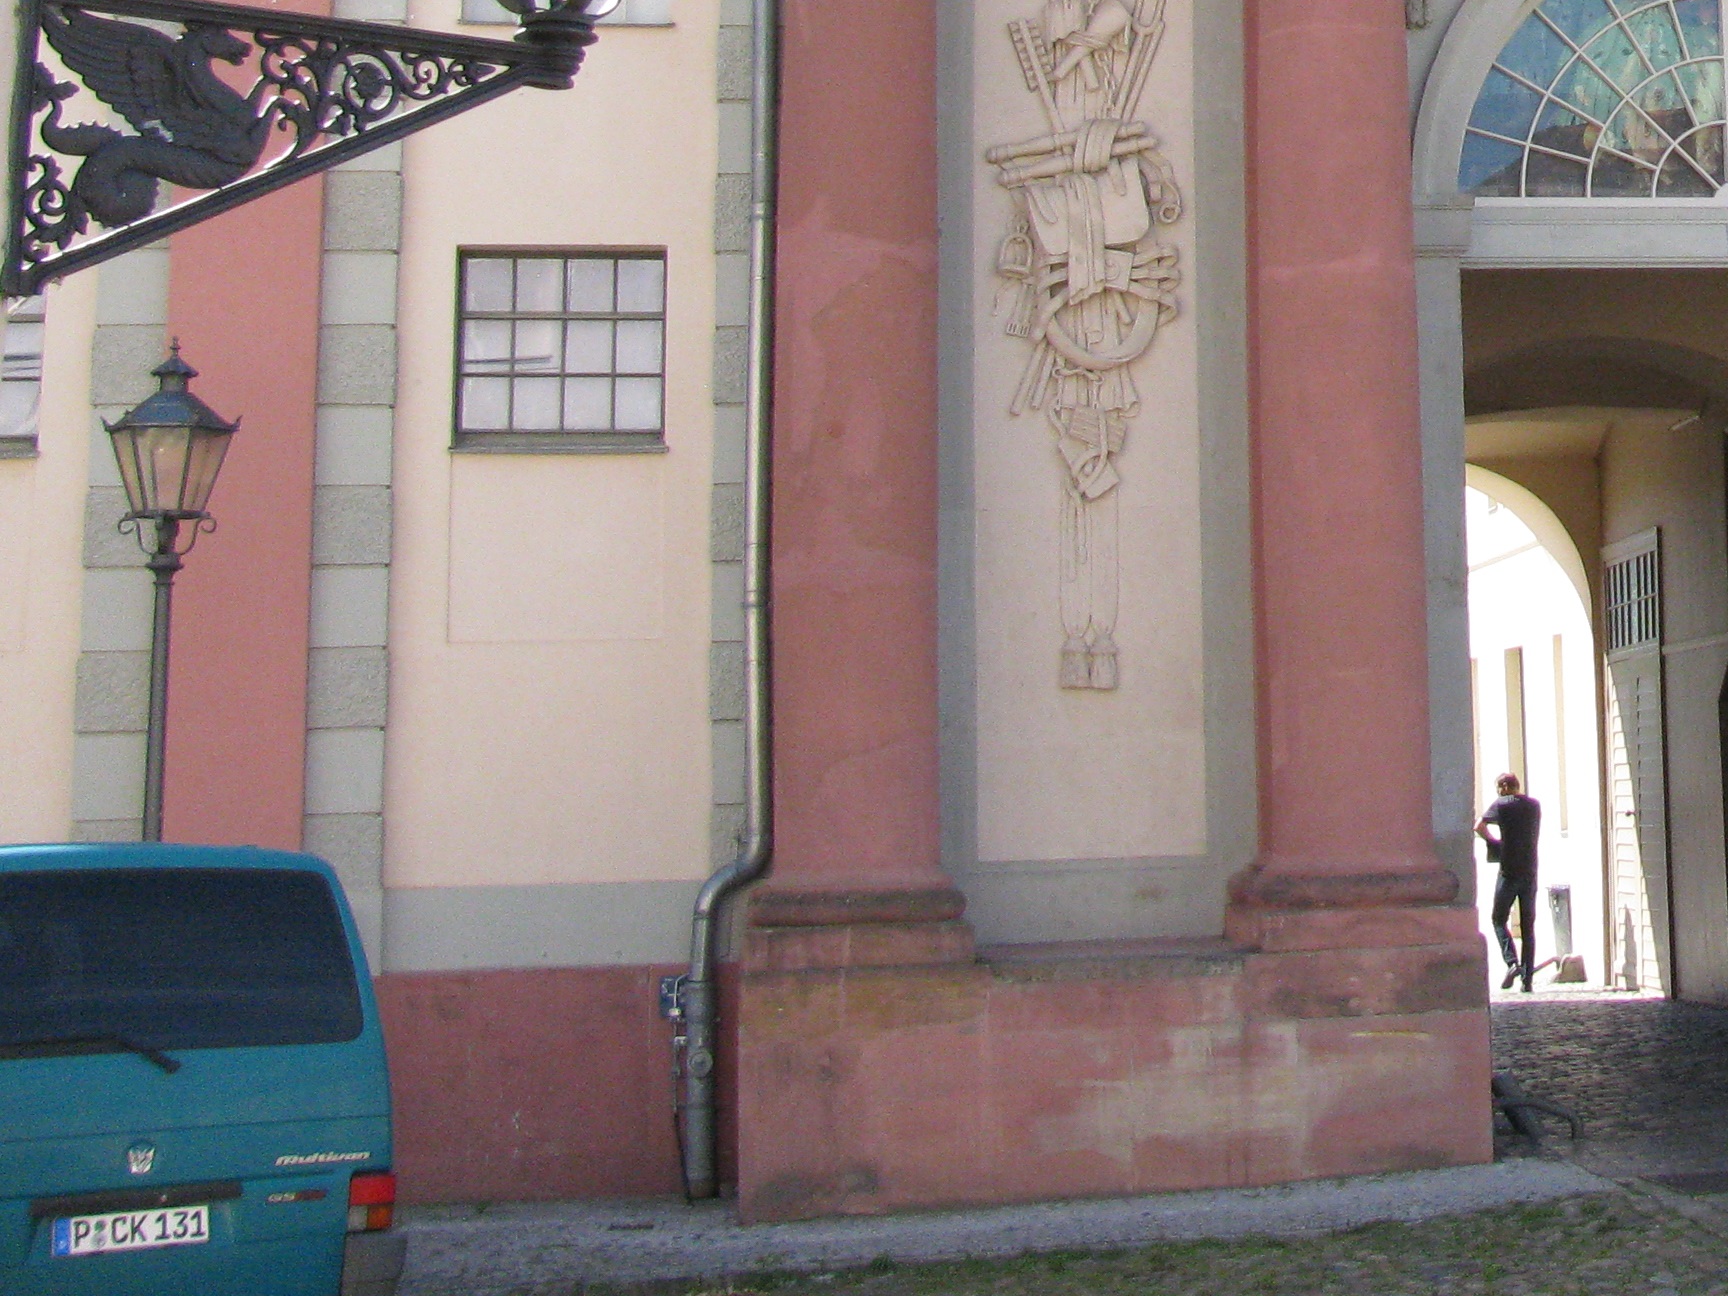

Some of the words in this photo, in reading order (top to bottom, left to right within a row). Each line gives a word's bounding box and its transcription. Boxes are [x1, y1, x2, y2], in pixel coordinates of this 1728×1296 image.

[73, 1219, 91, 1249] P
[110, 1214, 149, 1245] CK
[154, 1210, 207, 1242] 131
